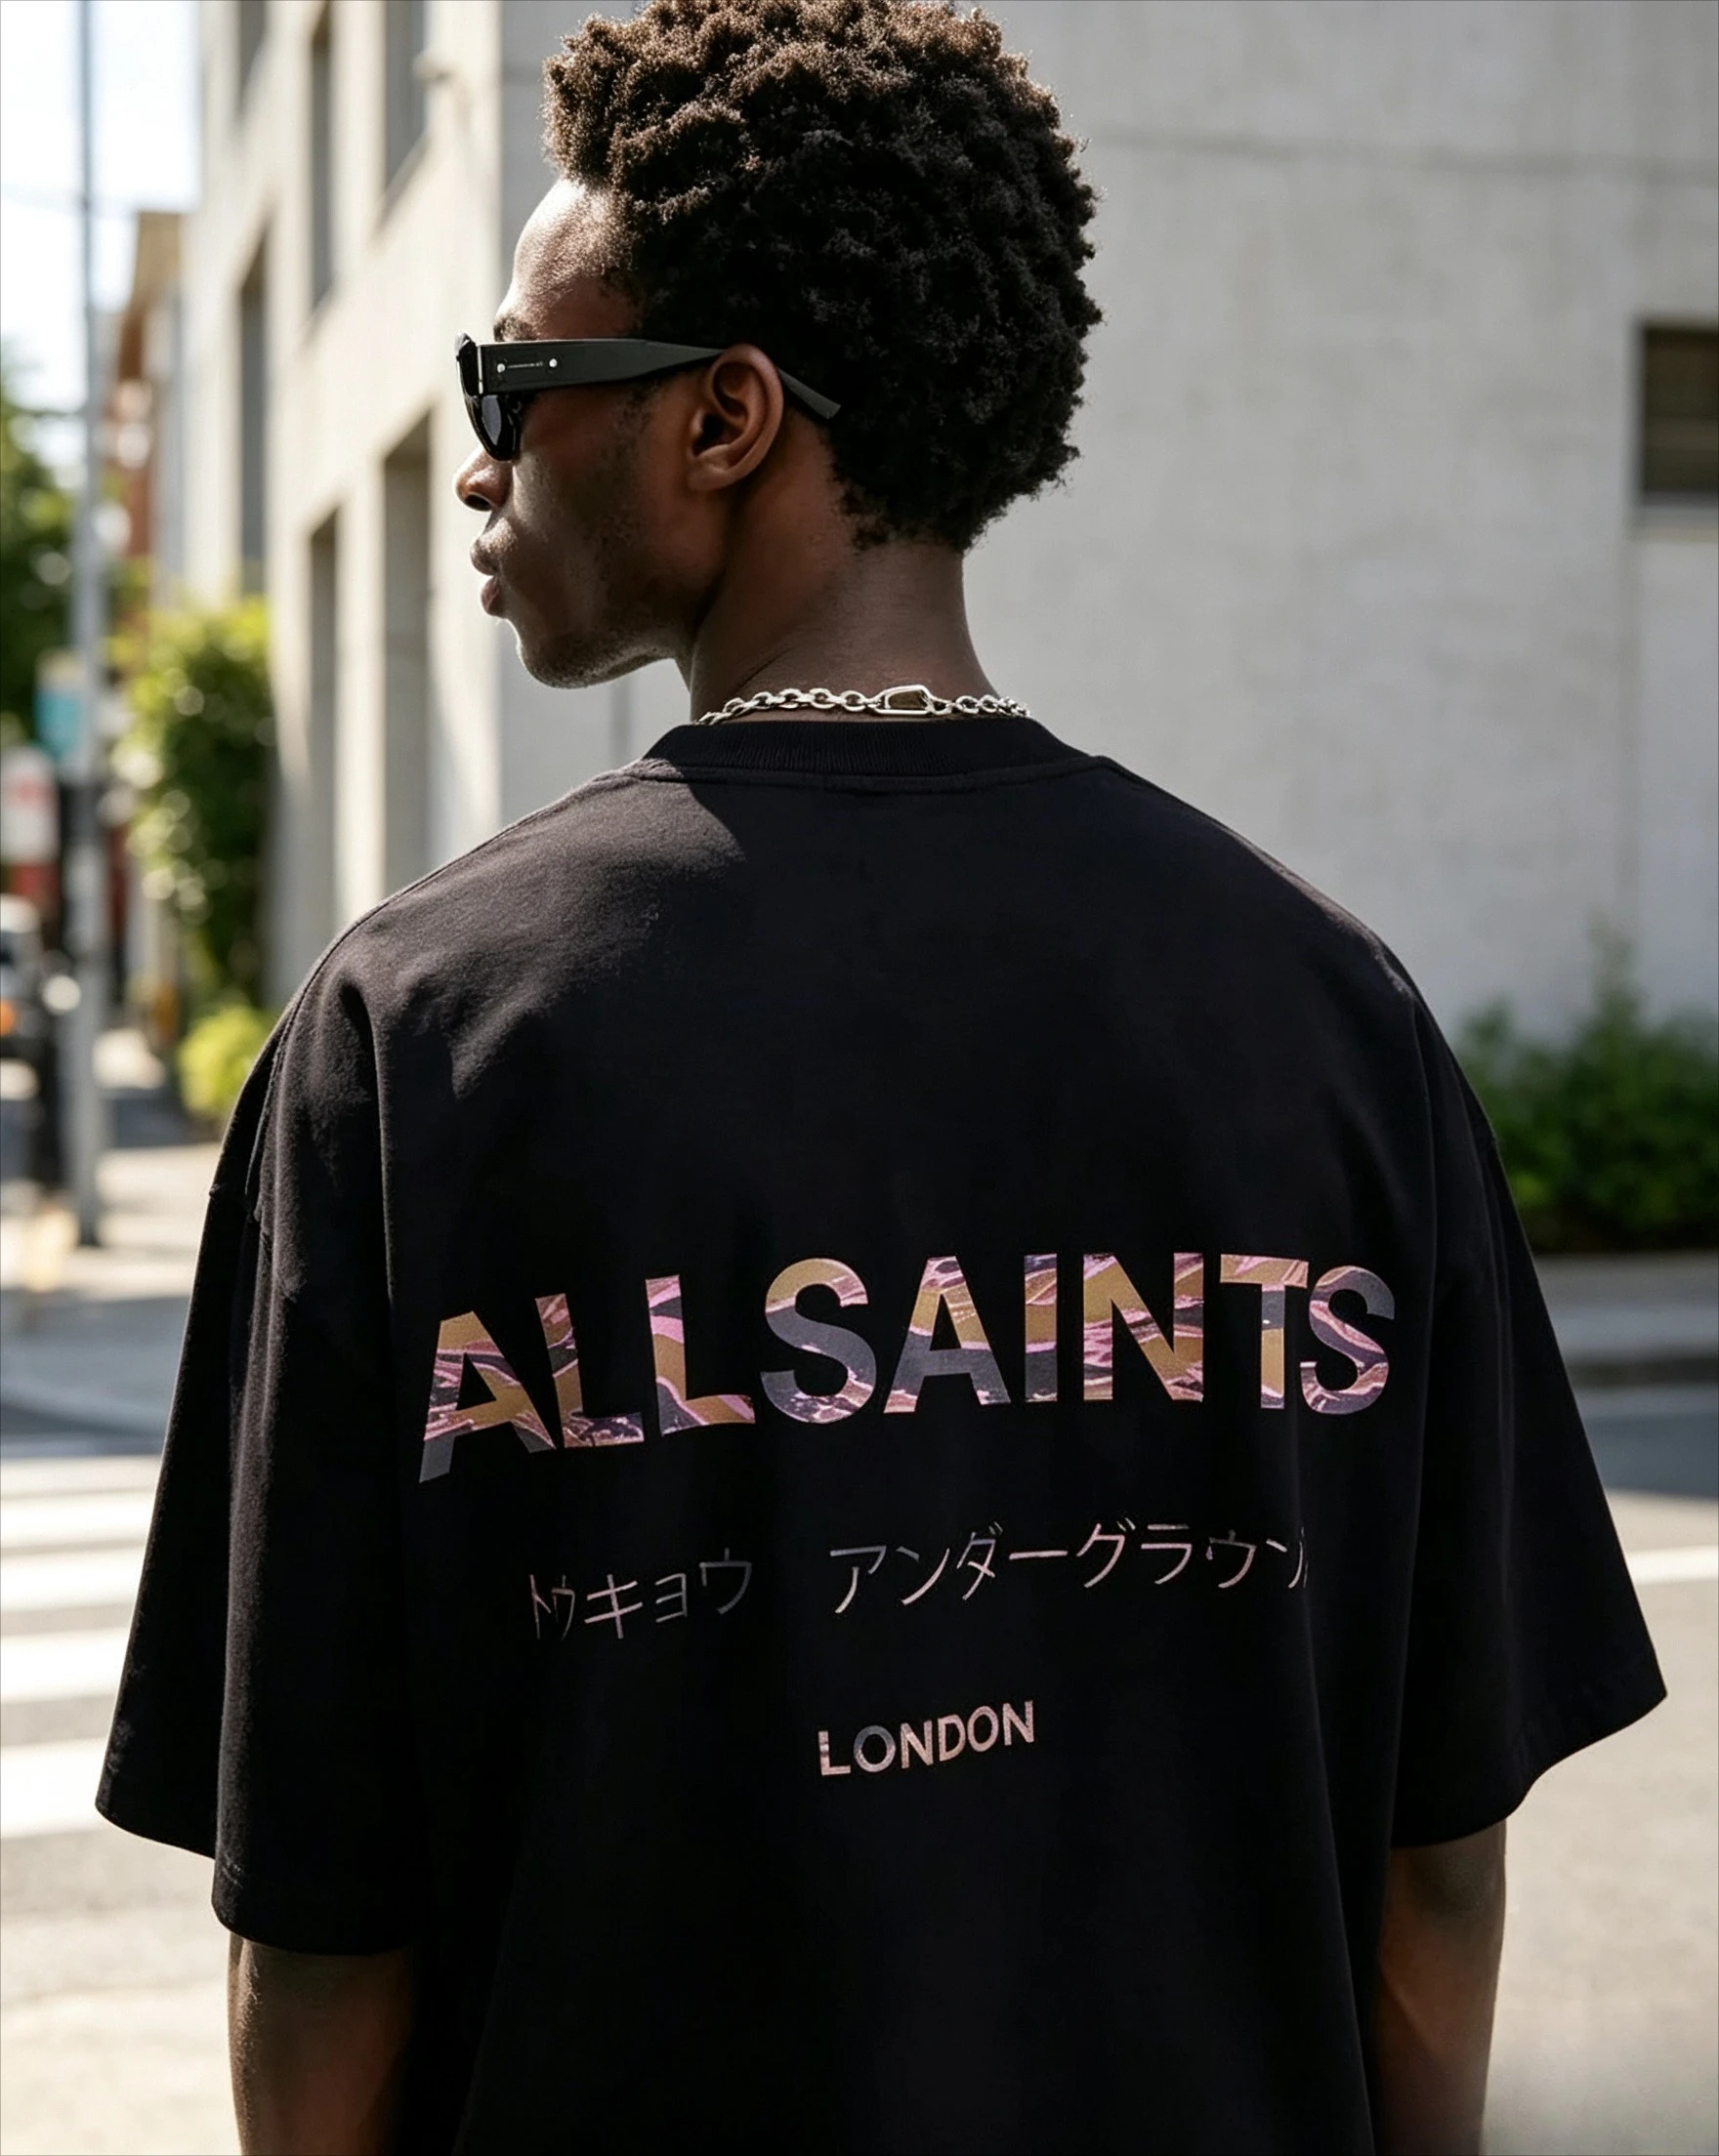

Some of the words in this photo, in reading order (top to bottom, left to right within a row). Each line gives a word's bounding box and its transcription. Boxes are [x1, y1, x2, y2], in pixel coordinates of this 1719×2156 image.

[420, 1253, 1395, 1482] ALLSAINTS
[829, 1516, 1309, 1614] アンダーグラウン
[818, 1699, 1035, 1777] LONDON
